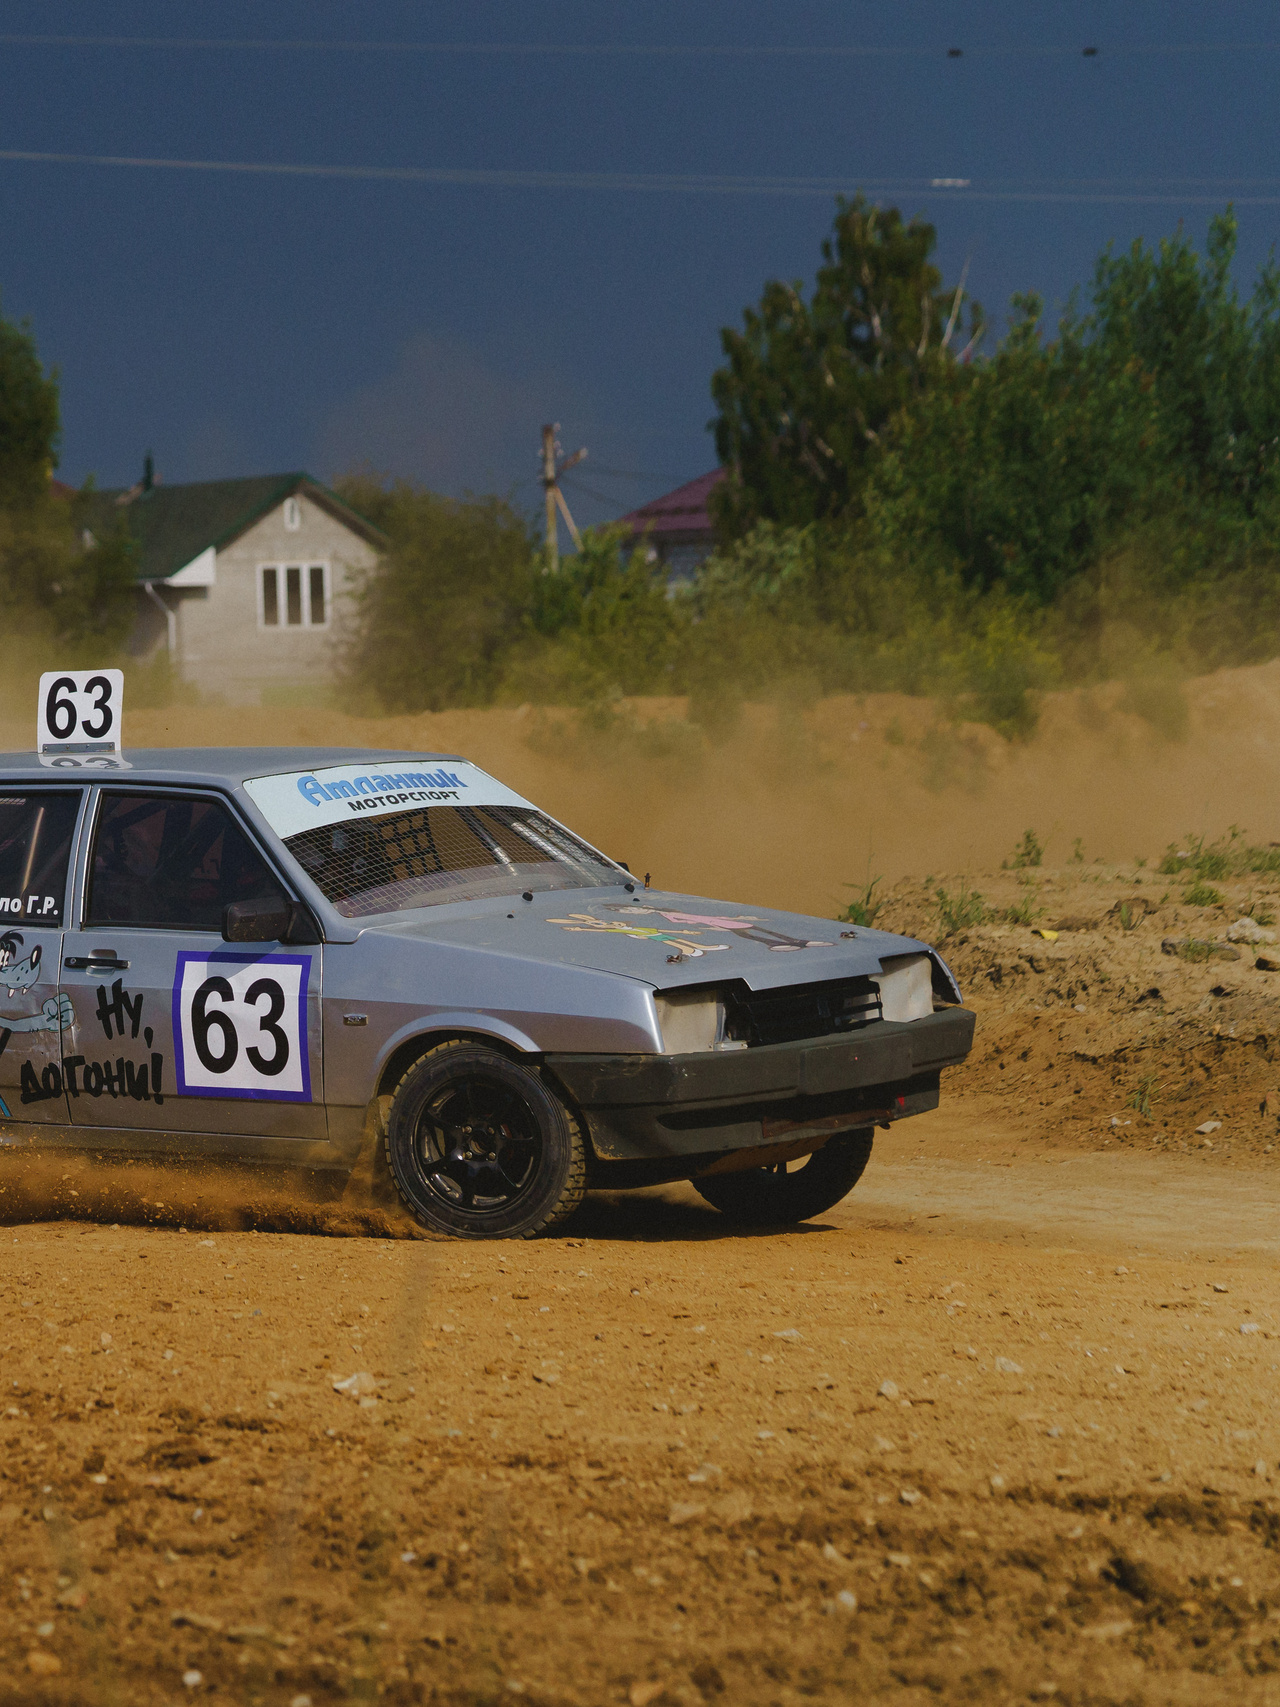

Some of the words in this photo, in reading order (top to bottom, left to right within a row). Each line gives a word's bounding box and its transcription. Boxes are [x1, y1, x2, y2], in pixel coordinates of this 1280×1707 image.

[45, 675, 113, 739] 63
[296, 768, 469, 807] Атлантик
[347, 791, 460, 811] МОТОРСПОРТ
[26, 895, 59, 915] Г.Р.
[191, 975, 290, 1076] 63
